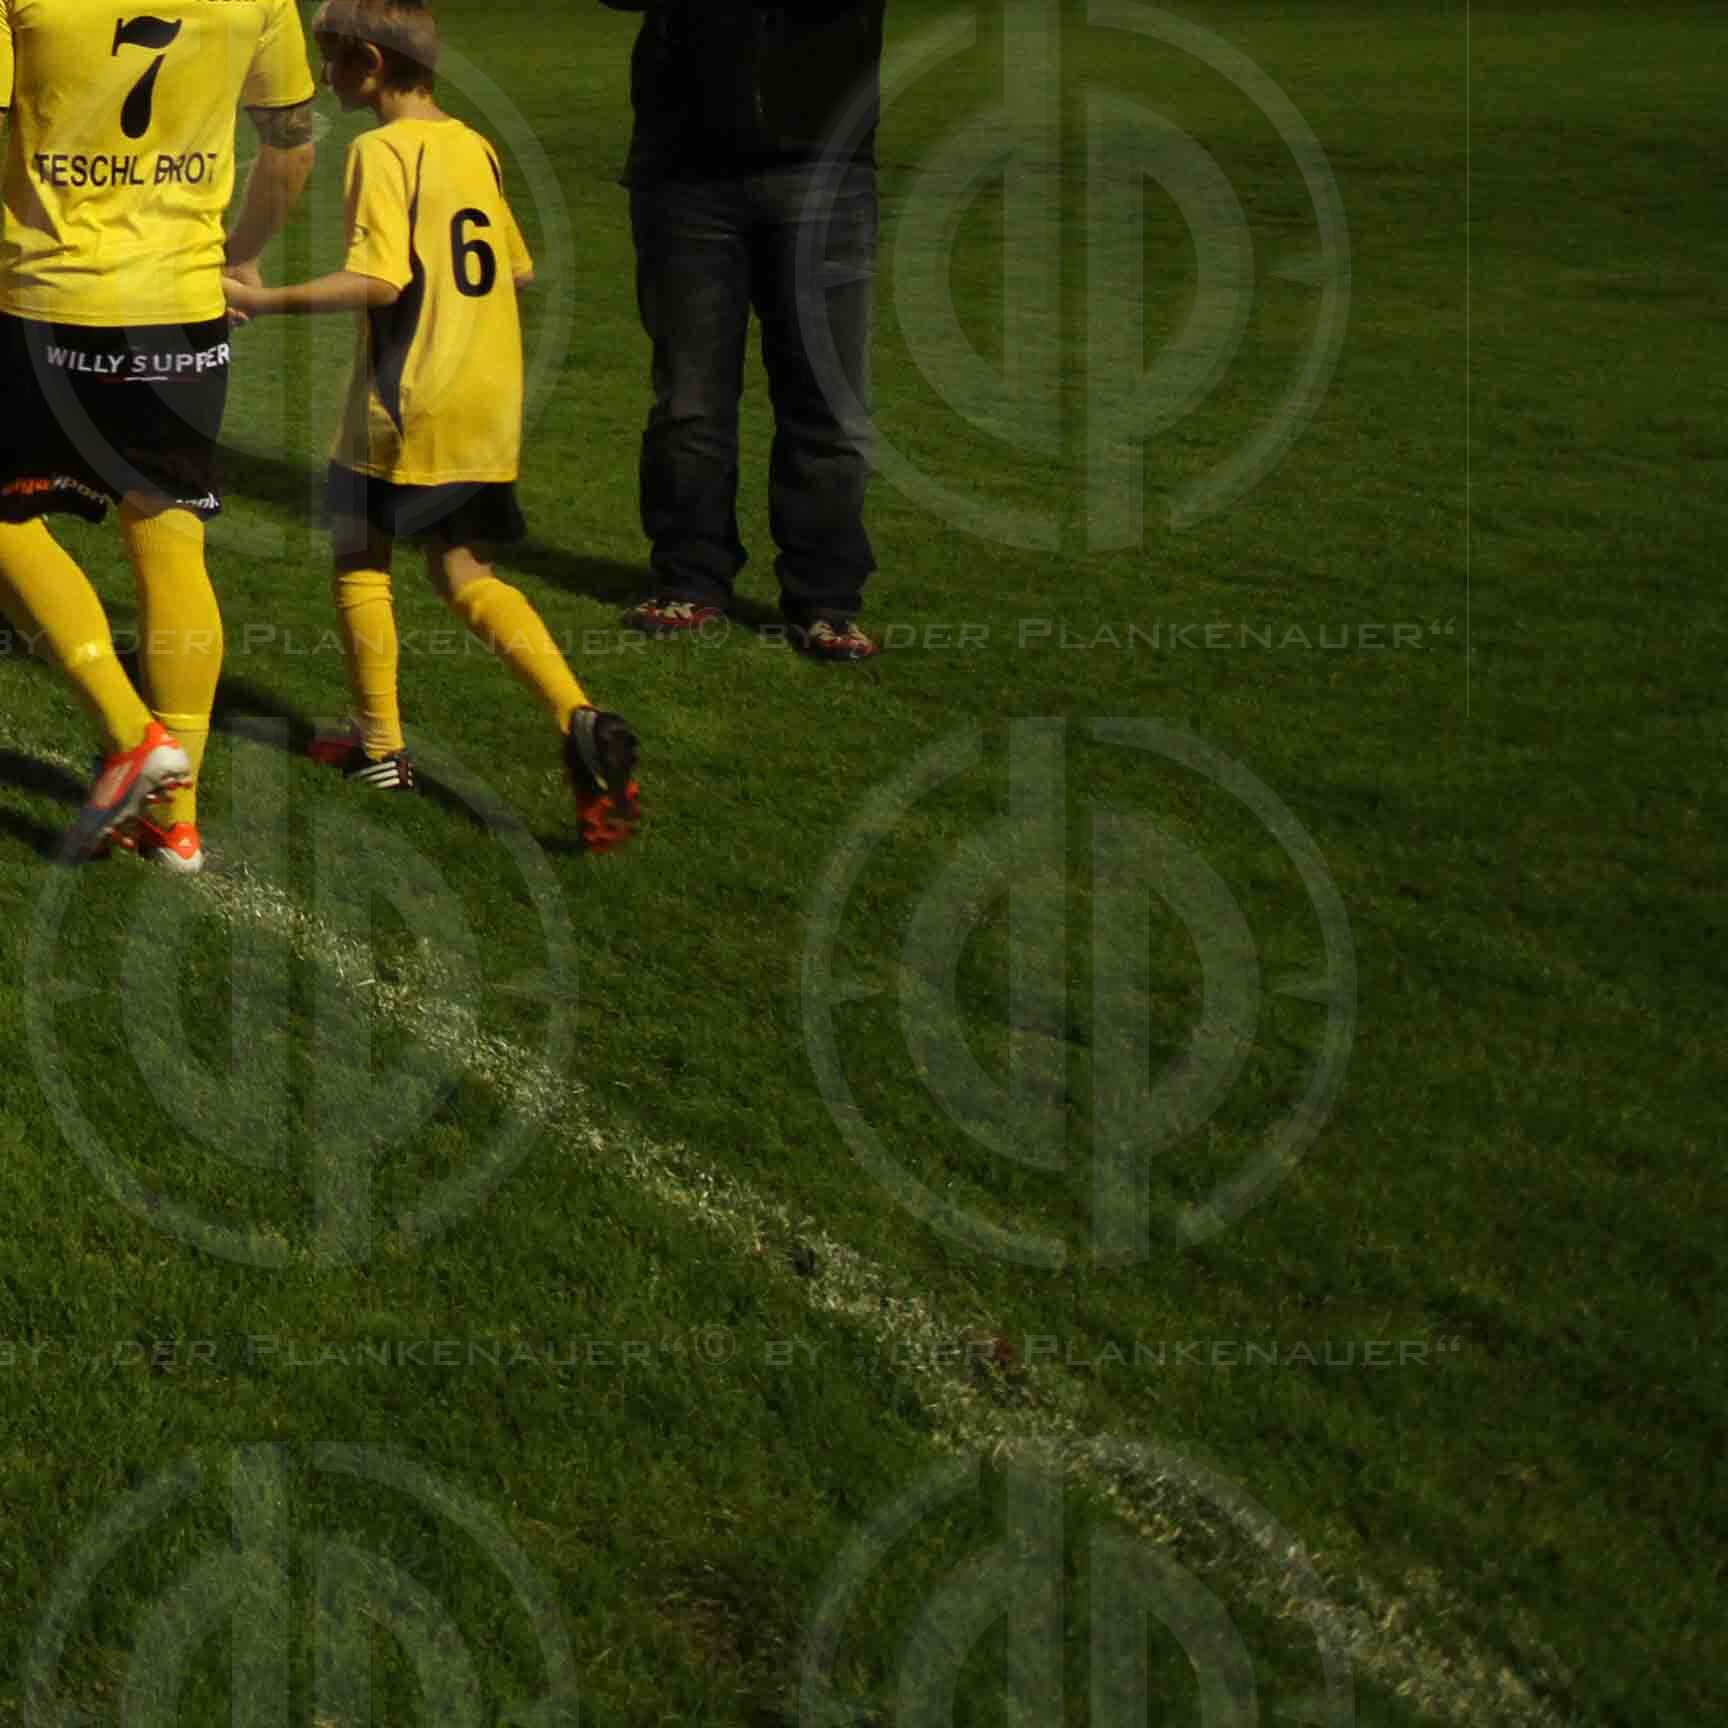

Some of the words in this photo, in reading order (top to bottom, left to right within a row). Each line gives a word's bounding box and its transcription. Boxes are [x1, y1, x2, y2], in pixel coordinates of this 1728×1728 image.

[111, 15, 183, 140] 7
[33, 152, 144, 186] TESCHL
[154, 152, 217, 186] BROT
[449, 207, 497, 297] 6
[47, 345, 125, 373] WILLY
